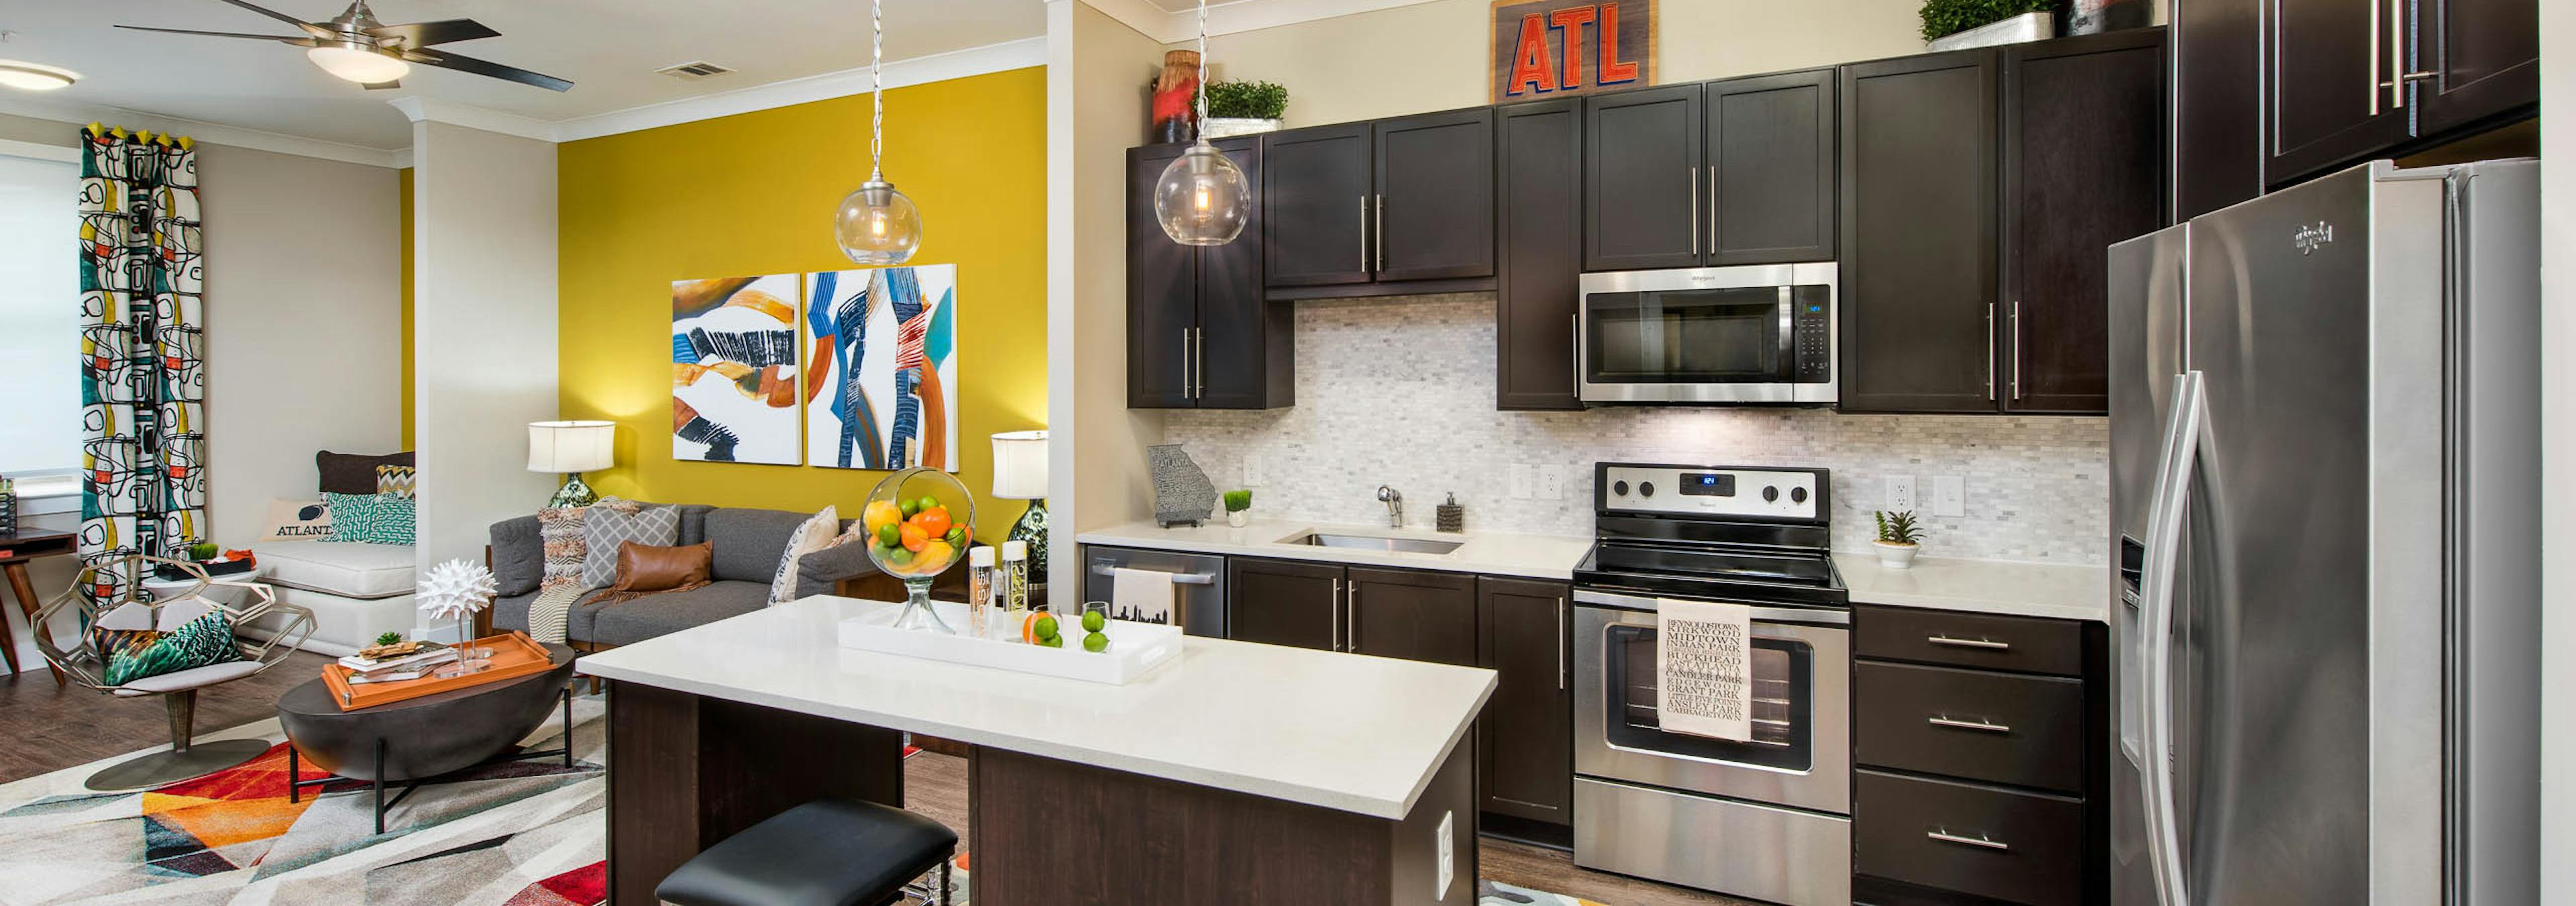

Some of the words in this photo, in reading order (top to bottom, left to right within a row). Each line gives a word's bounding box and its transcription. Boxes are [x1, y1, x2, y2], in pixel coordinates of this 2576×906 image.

[1505, 2, 1638, 97] ATL
[1159, 458, 1189, 468] ATLANTA
[276, 525, 333, 536] ATLANT
[1667, 619, 1739, 630] REYNOLDSTOWN
[1668, 625, 1741, 637] KIRKWOOD
[1668, 632, 1739, 645] MIDTOWN
[1666, 640, 1705, 649] INMAN
[1709, 643, 1740, 652] PARK
[1668, 652, 1741, 665] BUCKHEAD
[1666, 658, 1691, 667] EAST
[1694, 661, 1741, 674] ATLANTA
[1666, 670, 1713, 681] CANDLER
[1715, 674, 1742, 685] PARK
[1667, 677, 1740, 691] EDGEWOOD
[1667, 685, 1706, 695] GRANT
[1709, 689, 1739, 699] PARK
[1668, 693, 1693, 701] LITTLE
[1695, 695, 1711, 703] FIVE
[1667, 699, 1709, 711] ANSLEY
[1713, 704, 1741, 715] PARK
[1667, 707, 1741, 721] CABBAGETOWN
